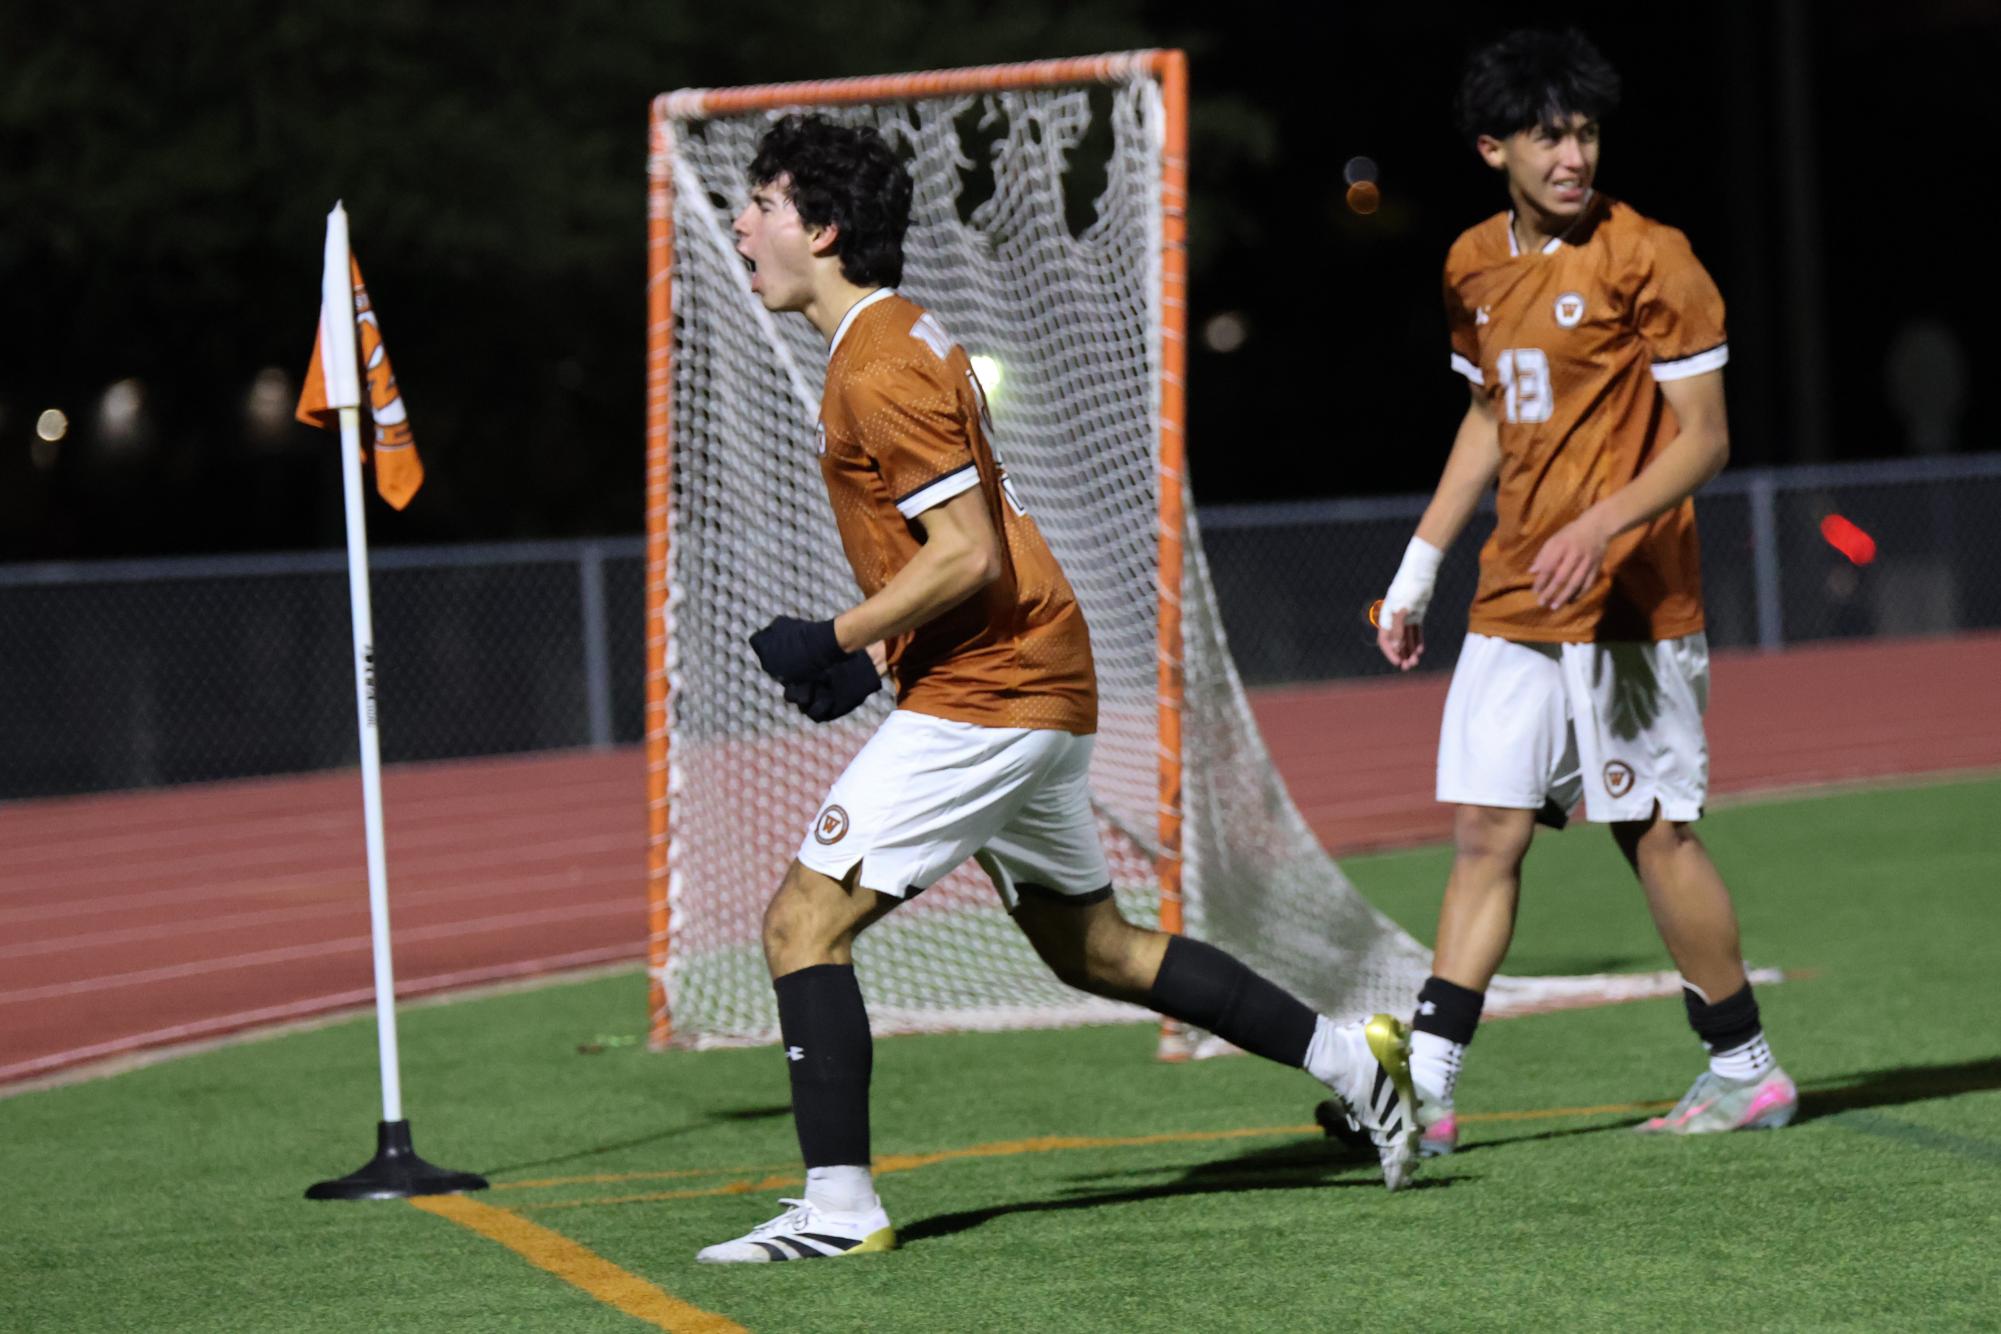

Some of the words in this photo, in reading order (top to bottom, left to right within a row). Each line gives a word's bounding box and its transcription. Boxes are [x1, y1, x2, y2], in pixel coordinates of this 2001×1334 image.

[1561, 303, 1578, 318] W
[1496, 348, 1554, 424] 13
[1608, 771, 1625, 786] W
[823, 815, 840, 834] W
